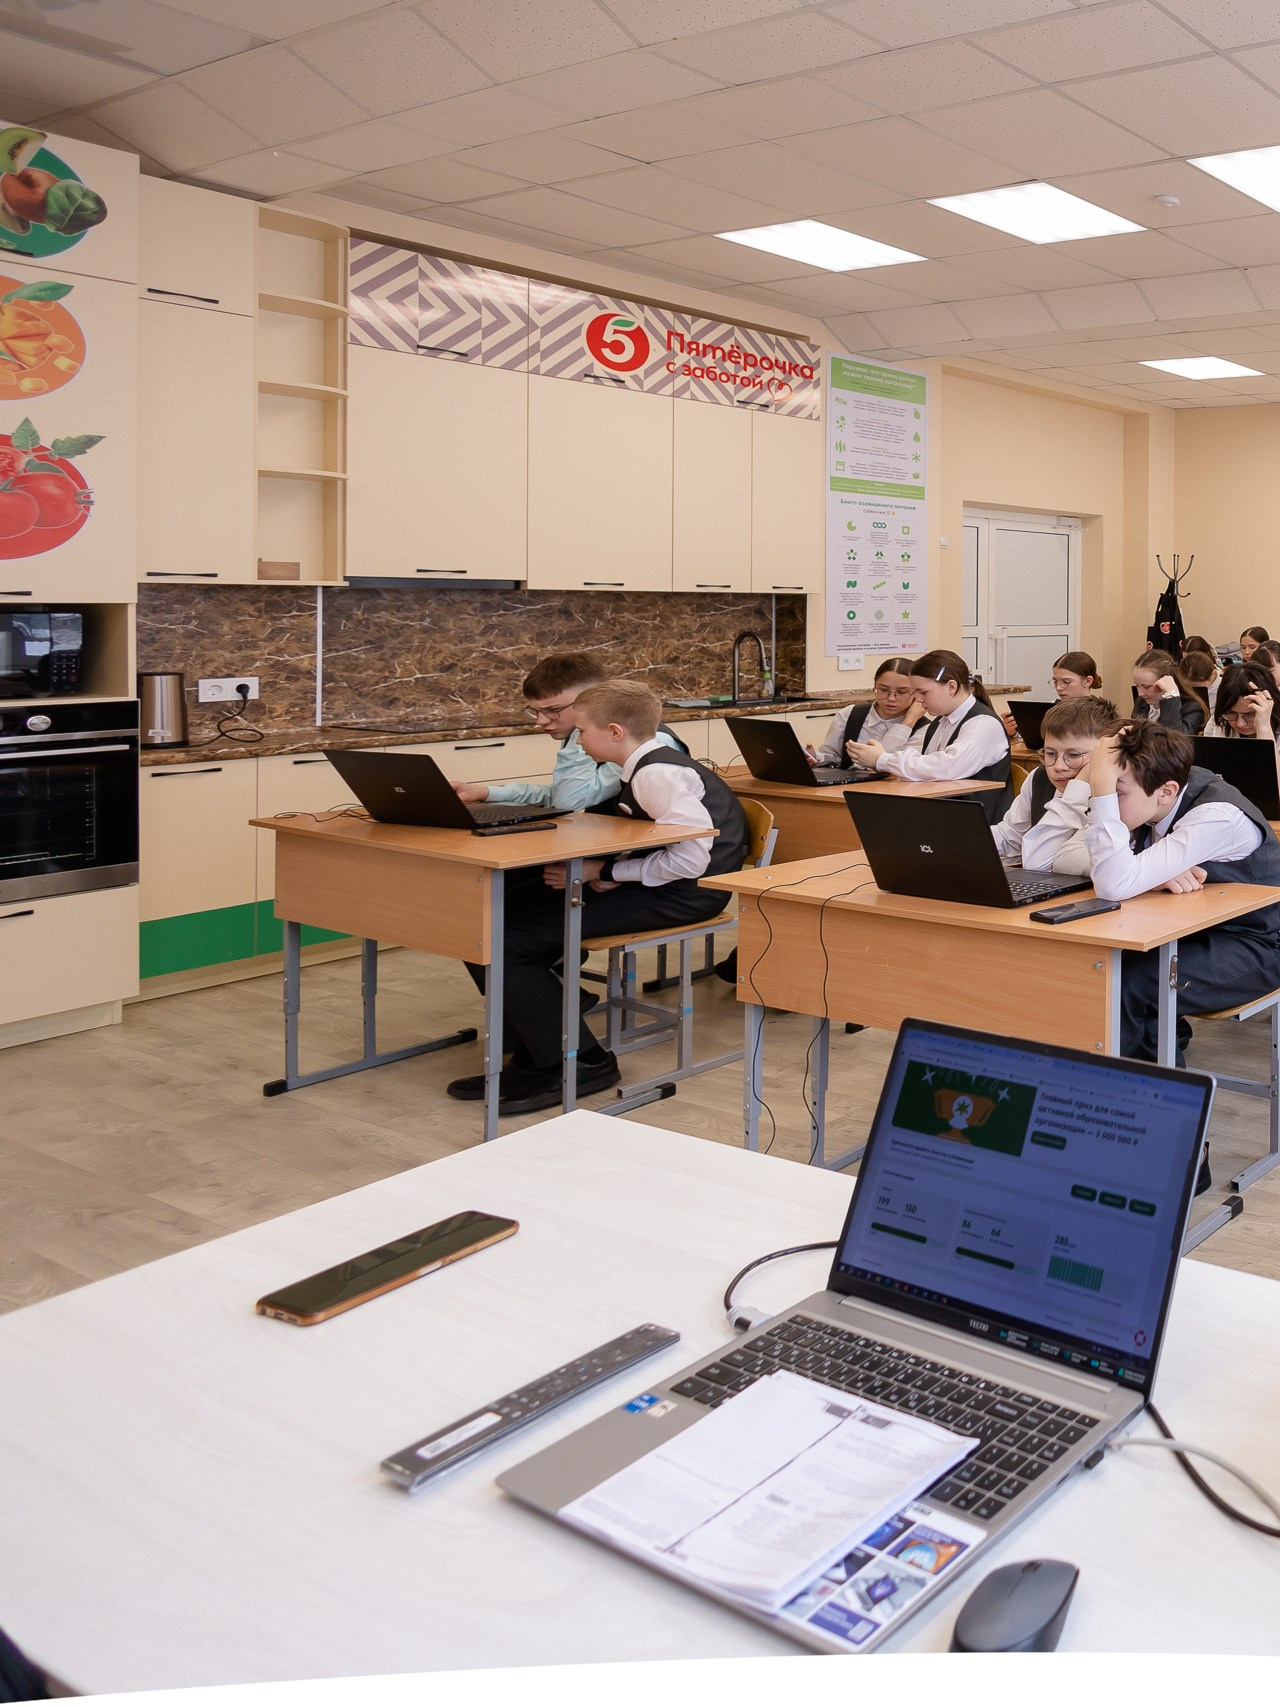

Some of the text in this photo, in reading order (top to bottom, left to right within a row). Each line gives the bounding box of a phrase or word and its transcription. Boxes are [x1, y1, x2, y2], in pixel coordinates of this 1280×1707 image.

[665, 361, 764, 390] с заботой
[666, 330, 815, 381] Пятёрочка
